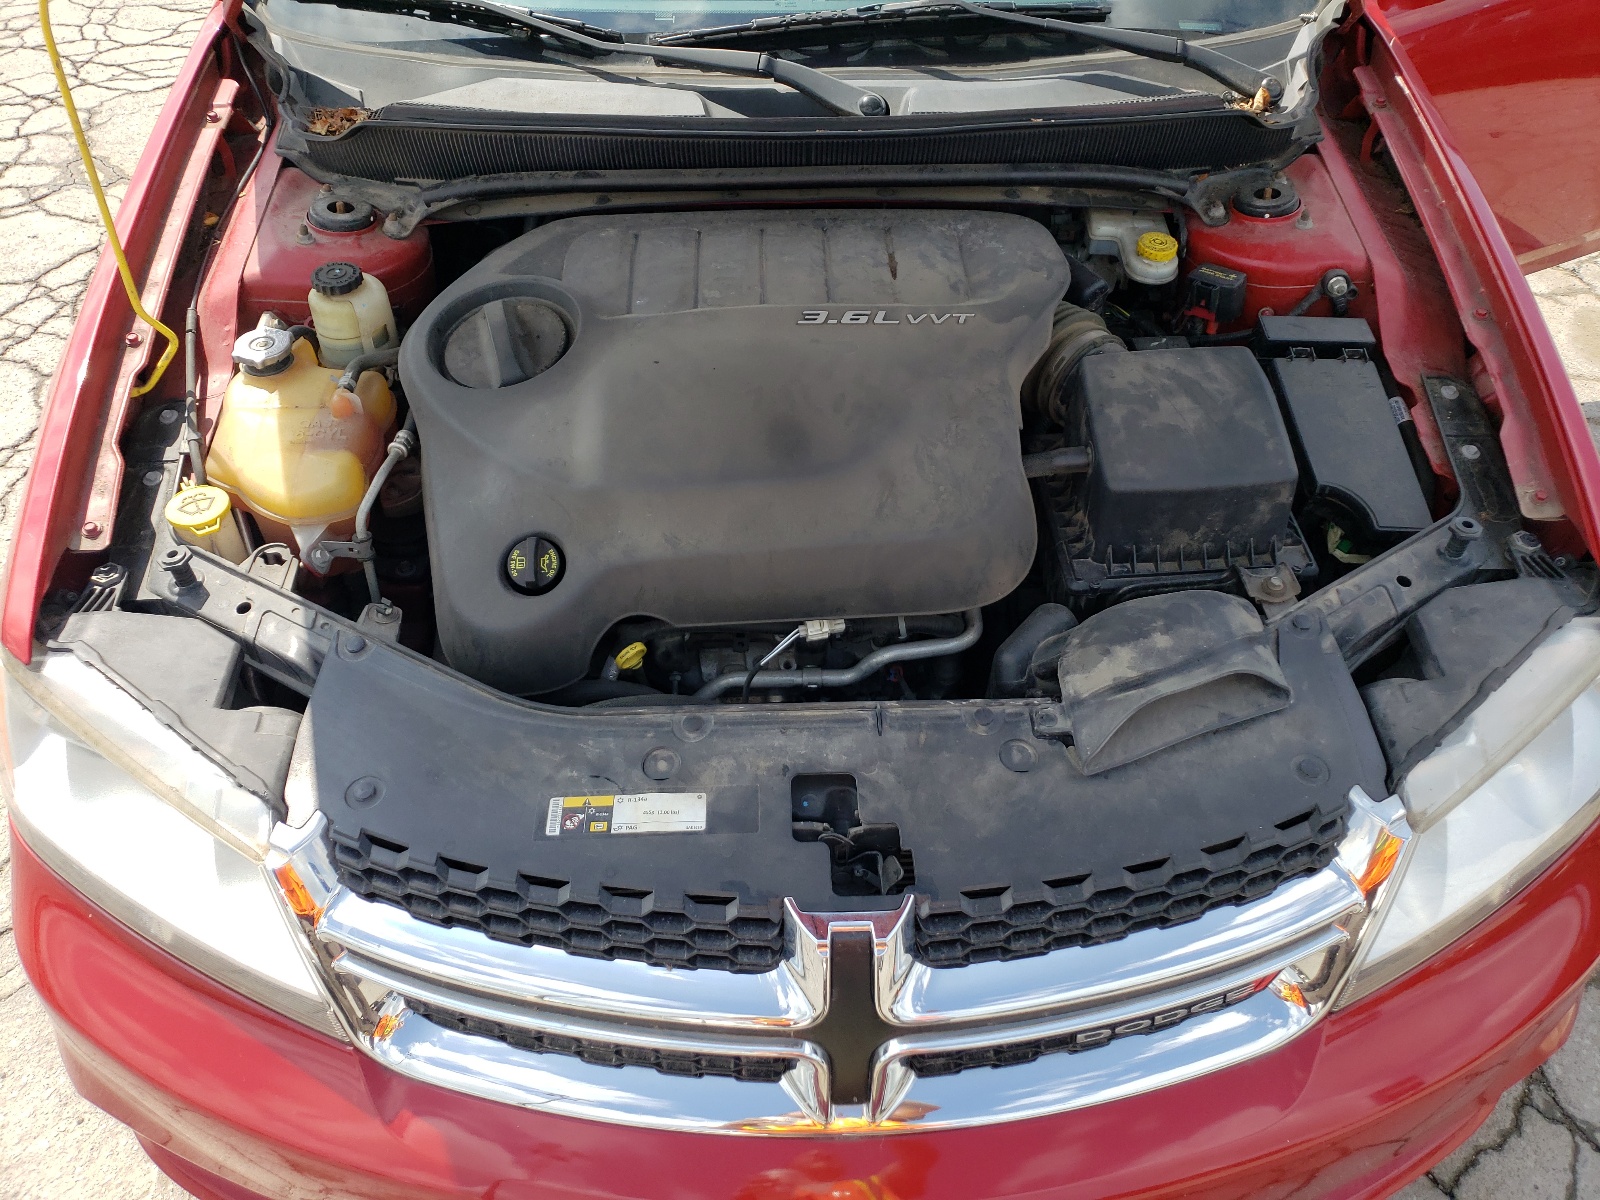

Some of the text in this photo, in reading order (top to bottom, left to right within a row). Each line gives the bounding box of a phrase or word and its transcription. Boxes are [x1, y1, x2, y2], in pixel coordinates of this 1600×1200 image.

[797, 310, 976, 325] 3.6L VVT
[546, 548, 558, 578] ENGINE OIL
[1076, 981, 1256, 1045] DODGE
